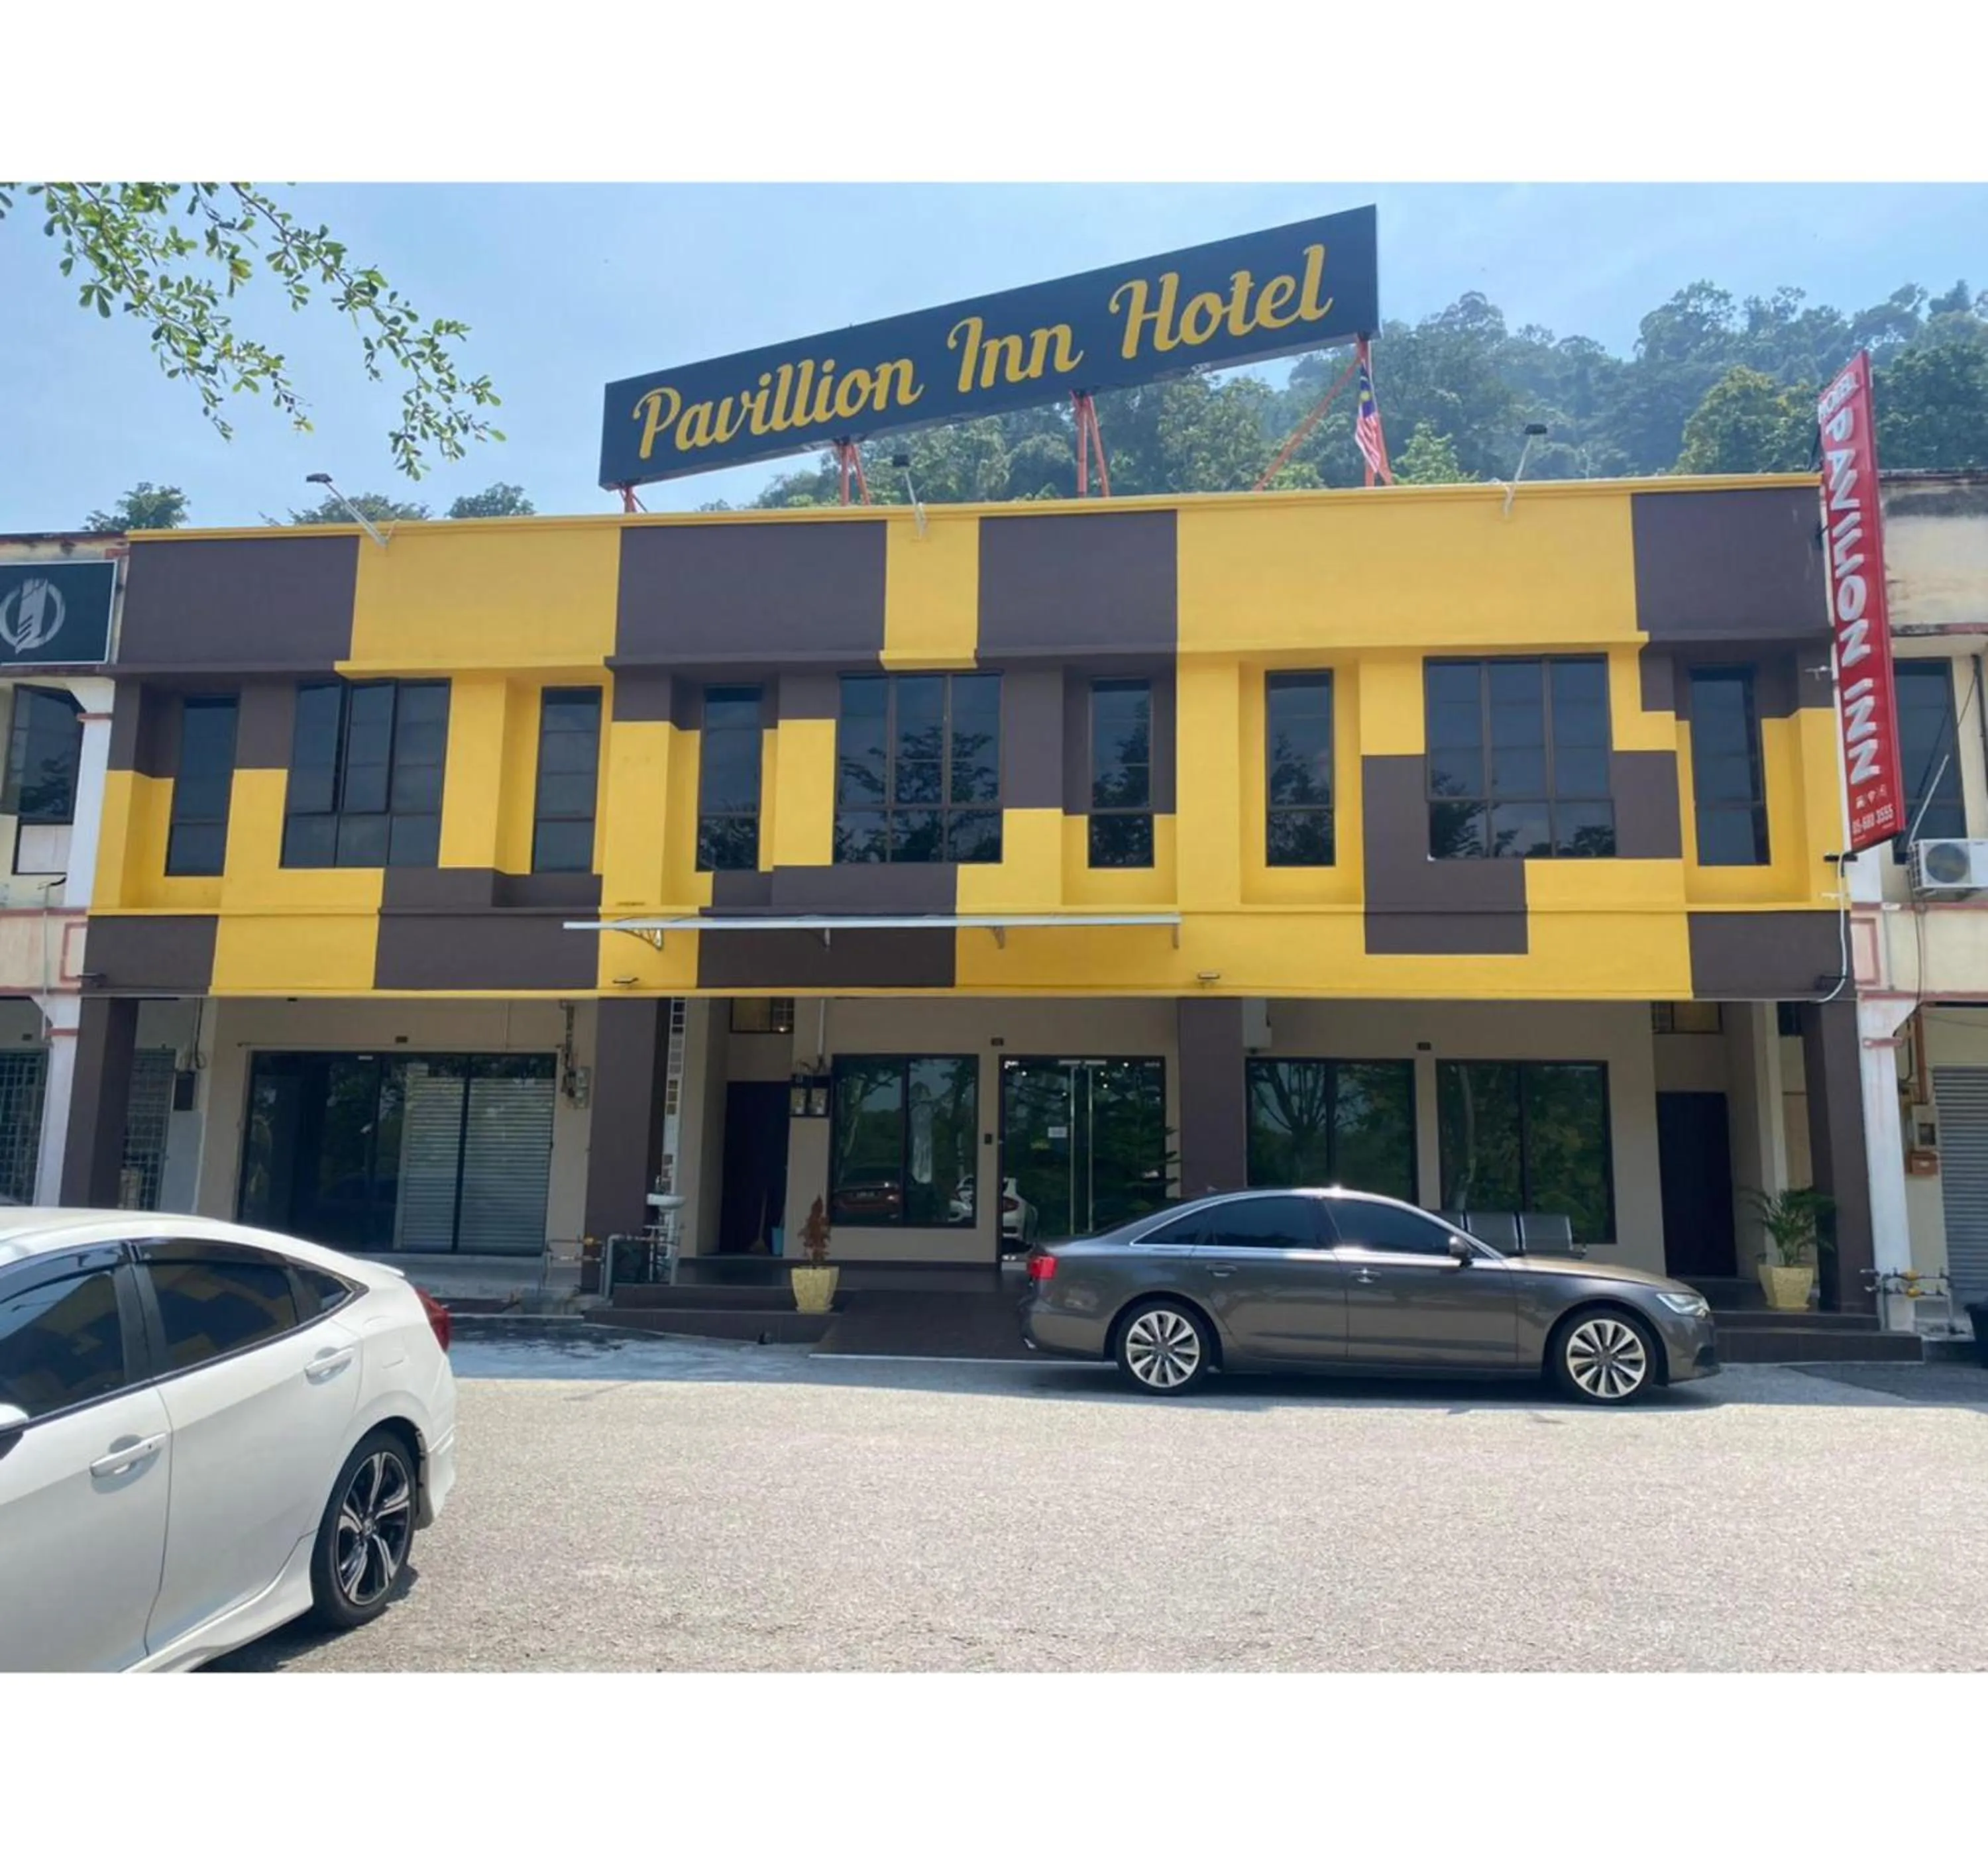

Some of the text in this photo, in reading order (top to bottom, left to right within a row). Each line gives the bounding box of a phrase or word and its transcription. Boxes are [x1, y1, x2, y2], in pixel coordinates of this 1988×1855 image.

[633, 243, 1334, 459] Pavillion Inn Hotel
[1826, 407, 1871, 667] PAVILION
[1844, 677, 1880, 784] INN
